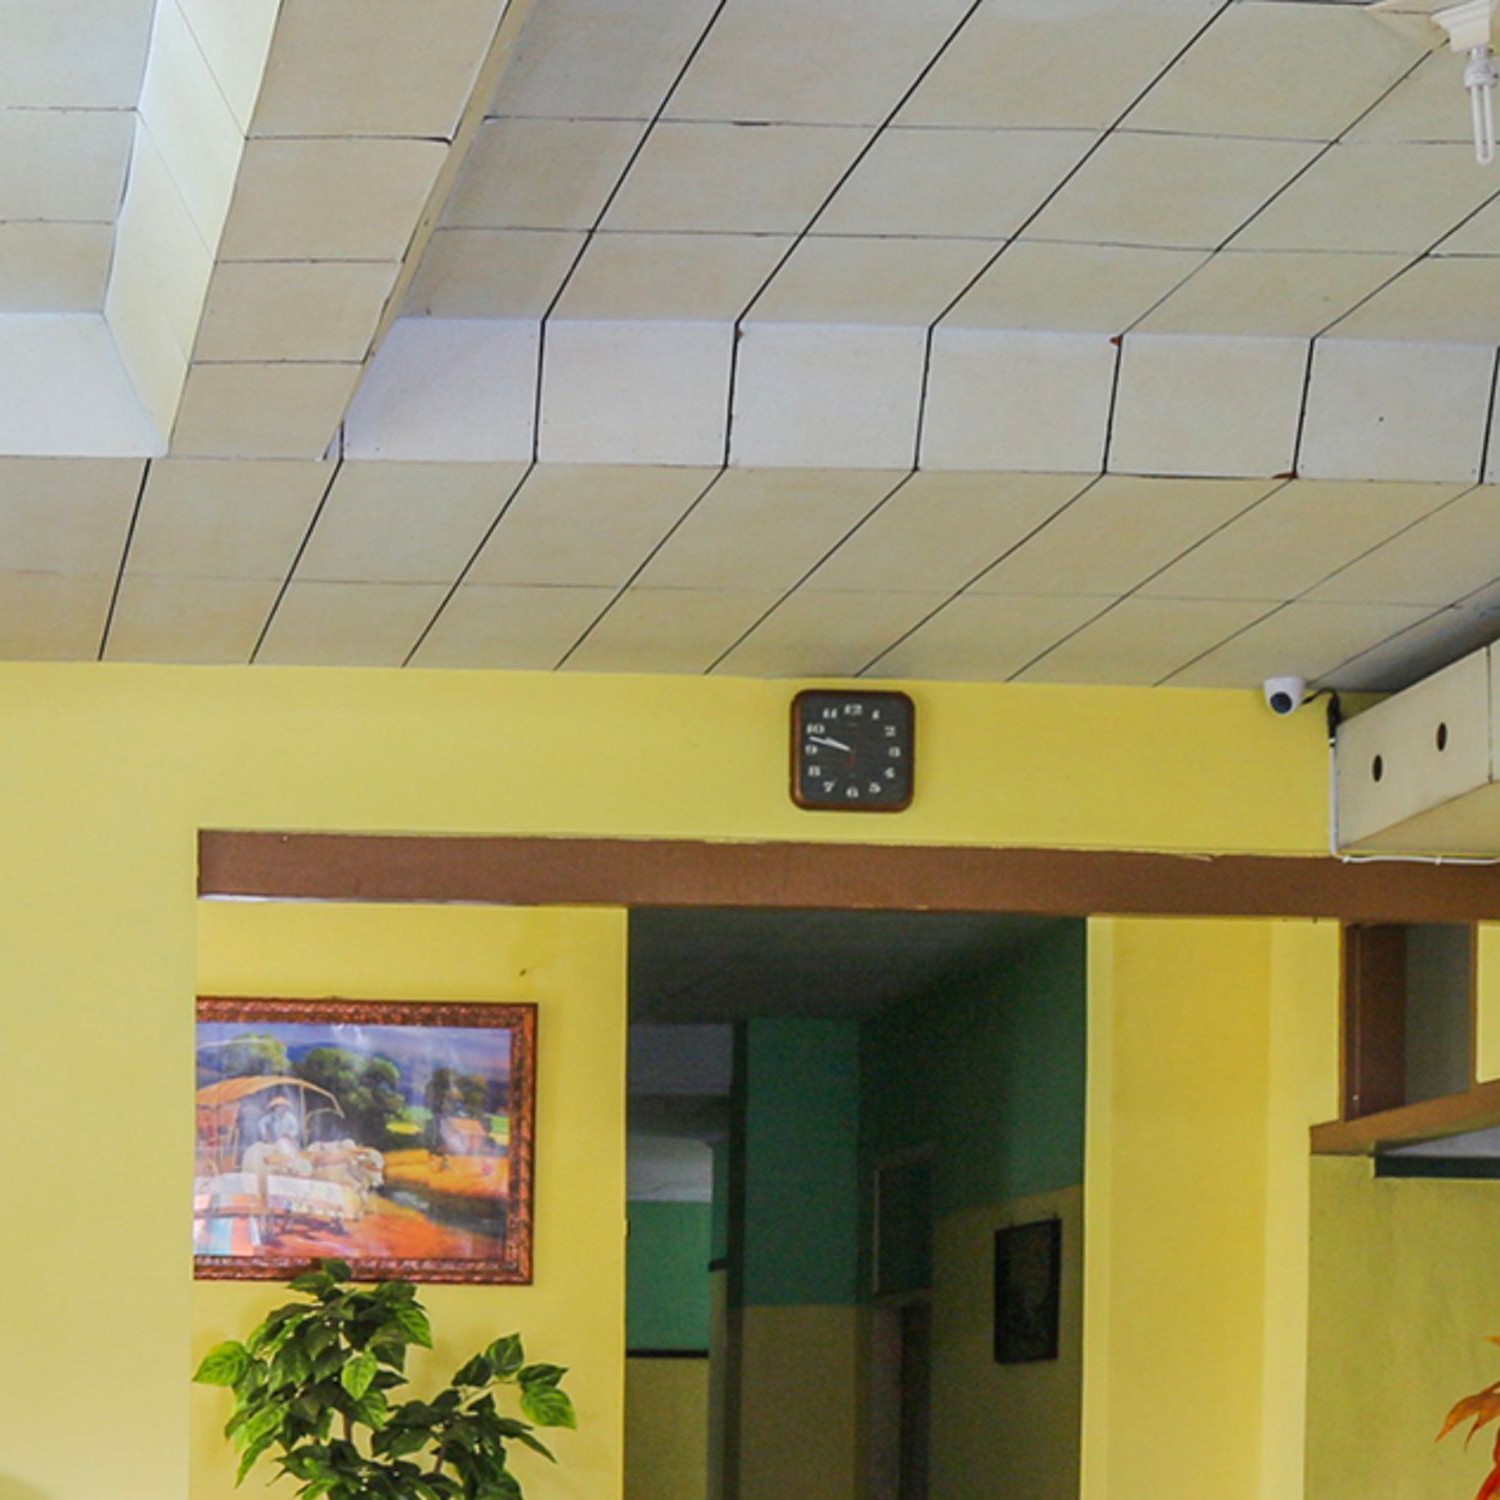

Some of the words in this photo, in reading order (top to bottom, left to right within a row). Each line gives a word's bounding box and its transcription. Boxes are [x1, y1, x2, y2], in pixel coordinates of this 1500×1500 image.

[844, 704, 863, 716] 12
[806, 723, 825, 734] 10
[823, 781, 835, 792] 7
[846, 786, 859, 798] 6
[869, 782, 881, 793] 5
